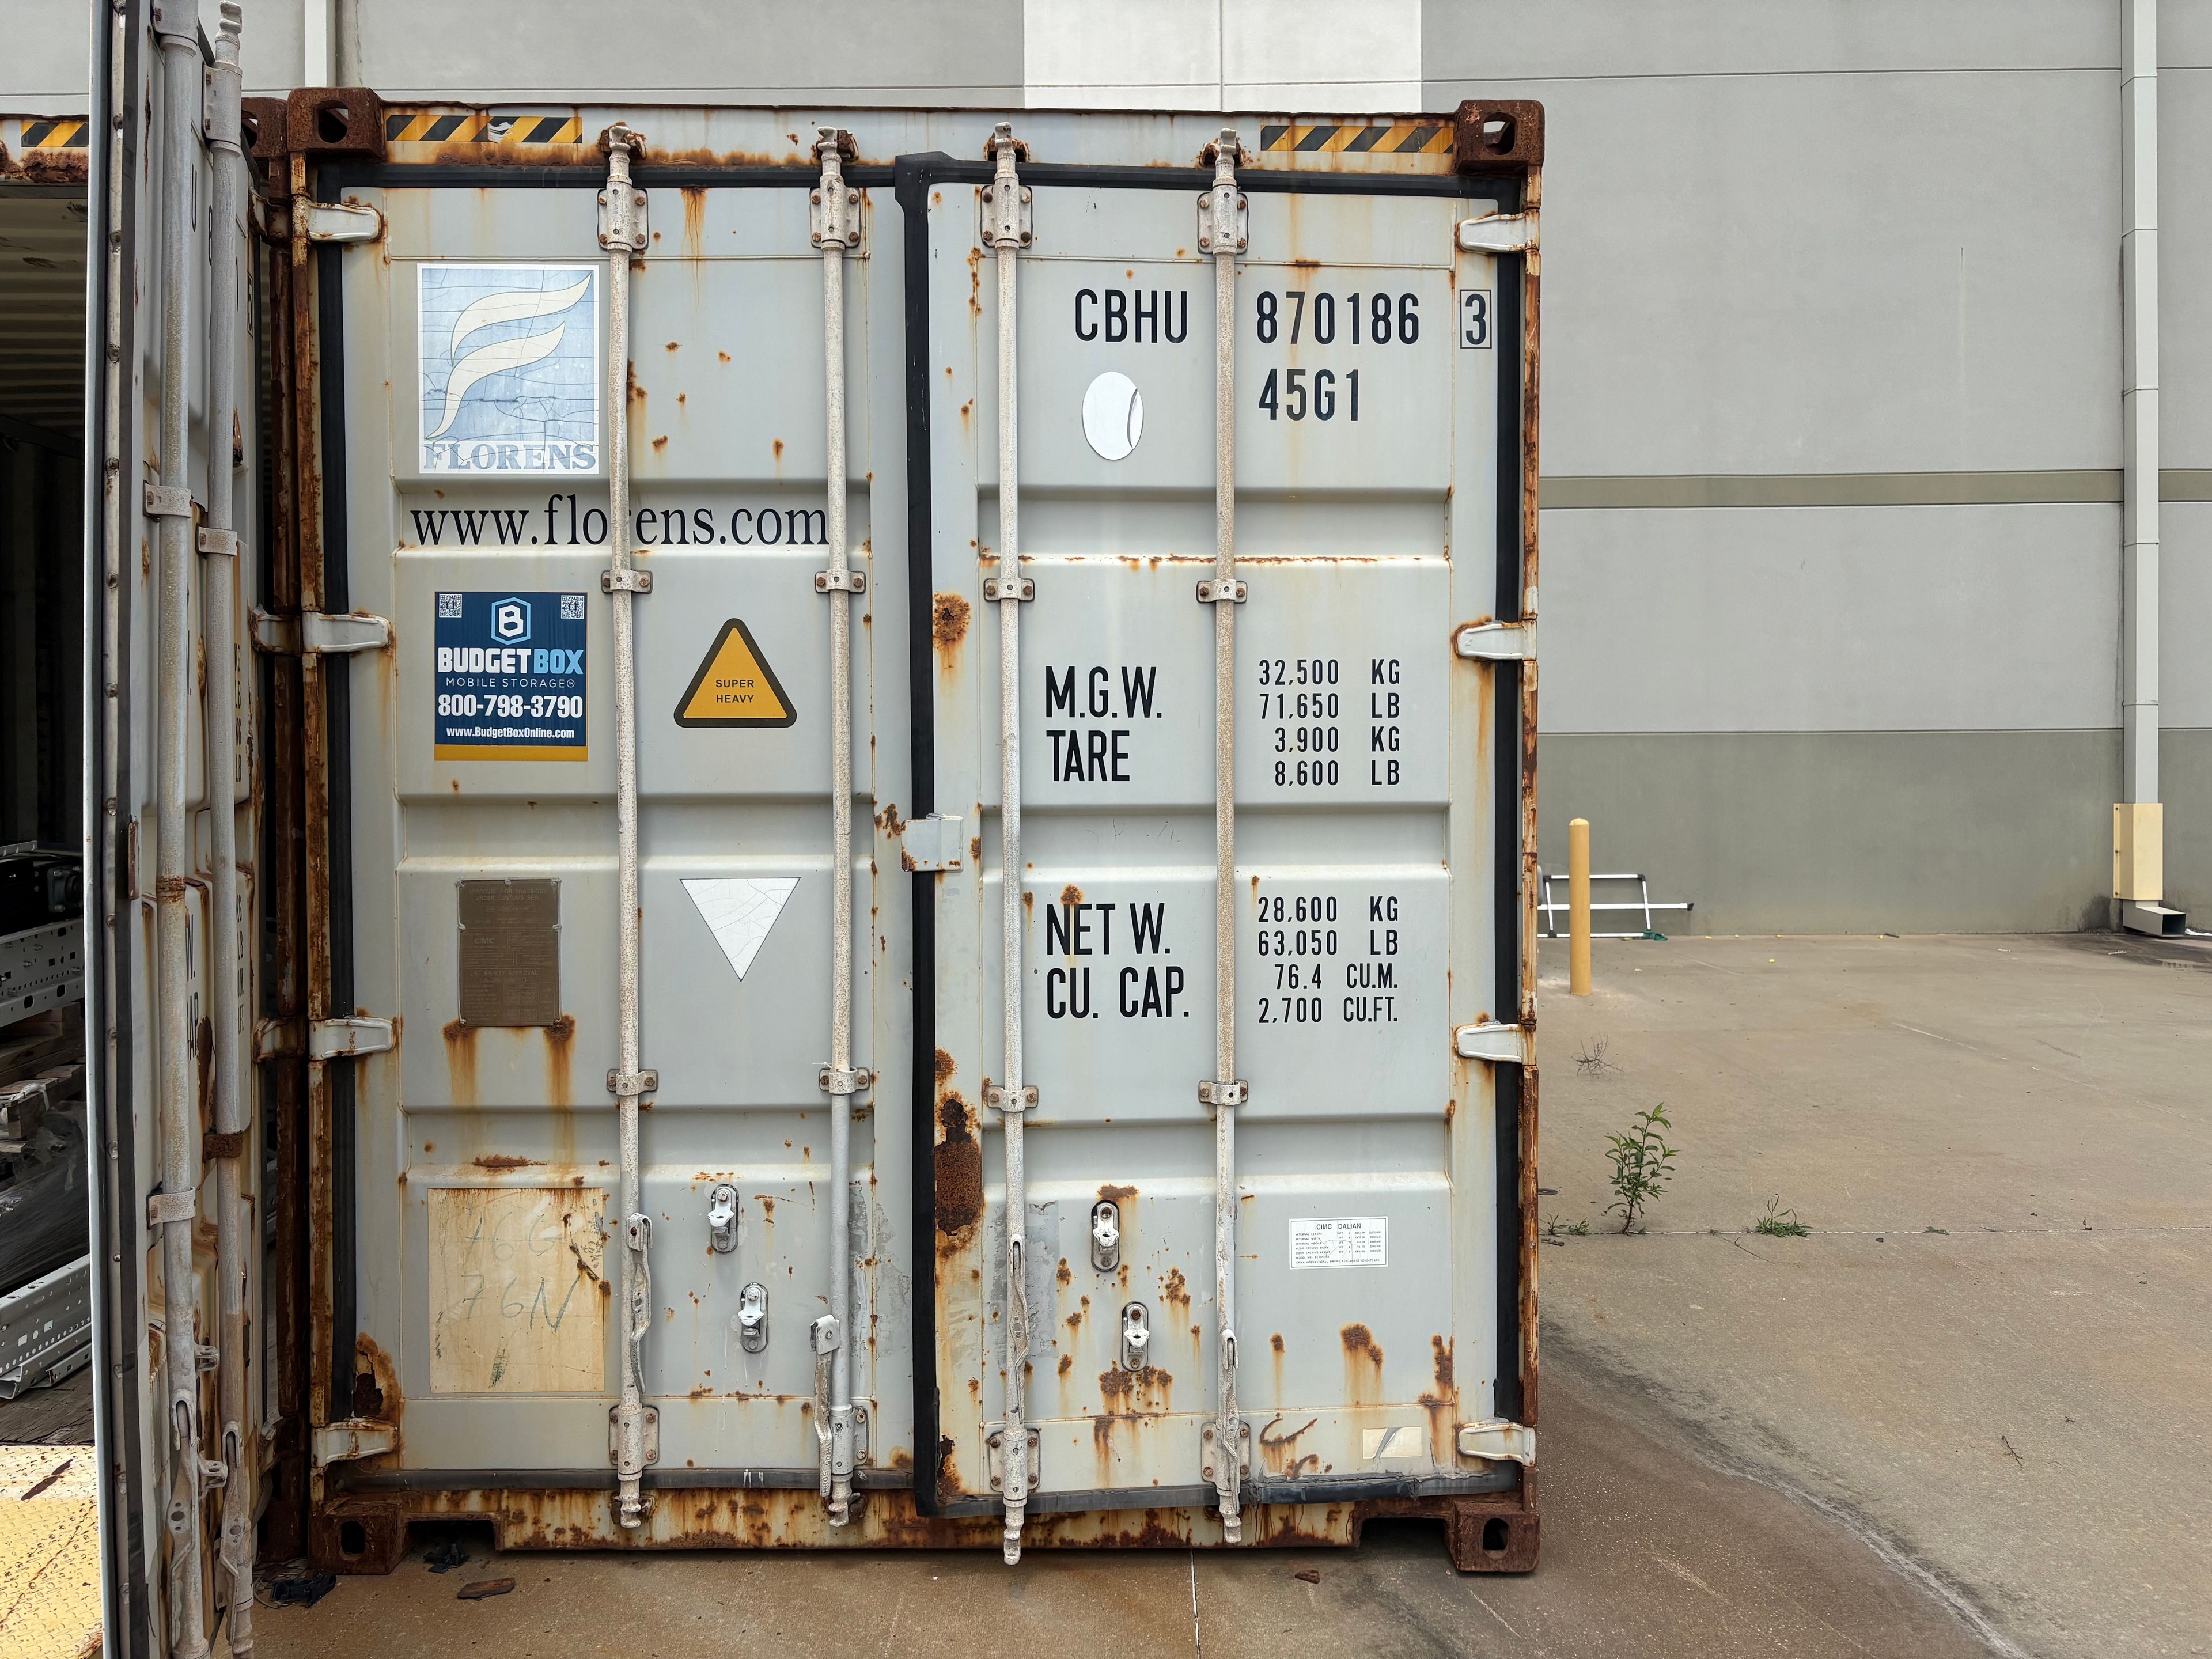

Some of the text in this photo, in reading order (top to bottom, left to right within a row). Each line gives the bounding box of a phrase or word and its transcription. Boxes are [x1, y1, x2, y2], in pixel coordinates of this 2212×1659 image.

[1075, 289, 1486, 344] CBHU 870186 3
[1259, 369, 1358, 421] 45G1
[423, 443, 596, 469] FLORENS
[410, 494, 830, 545] www.floens.com
[446, 678, 495, 687] MOBILE
[715, 679, 755, 688] SUPER
[1260, 659, 1399, 685] 32,500 KG
[716, 695, 755, 703] HEAVY
[1046, 666, 1161, 718] M.G.W.
[438, 694, 583, 718] 800-798-3790
[1260, 693, 1399, 719] 71,650 LB
[446, 726, 574, 738] www.BudgetBoxOnline.com
[1275, 726, 1399, 752] 3,900 KG
[1047, 730, 1130, 781] TARE
[1275, 760, 1399, 786] 8,600 LB
[1259, 896, 1397, 922] 28,600 KG
[1047, 903, 1170, 955] NET W.
[1259, 930, 1397, 956] 63,050 LB
[1275, 963, 1397, 989] 76.4 CU.M.
[1047, 967, 1188, 1018] CU. CAP.
[1259, 997, 1397, 1023] 2,700 CU.FT.
